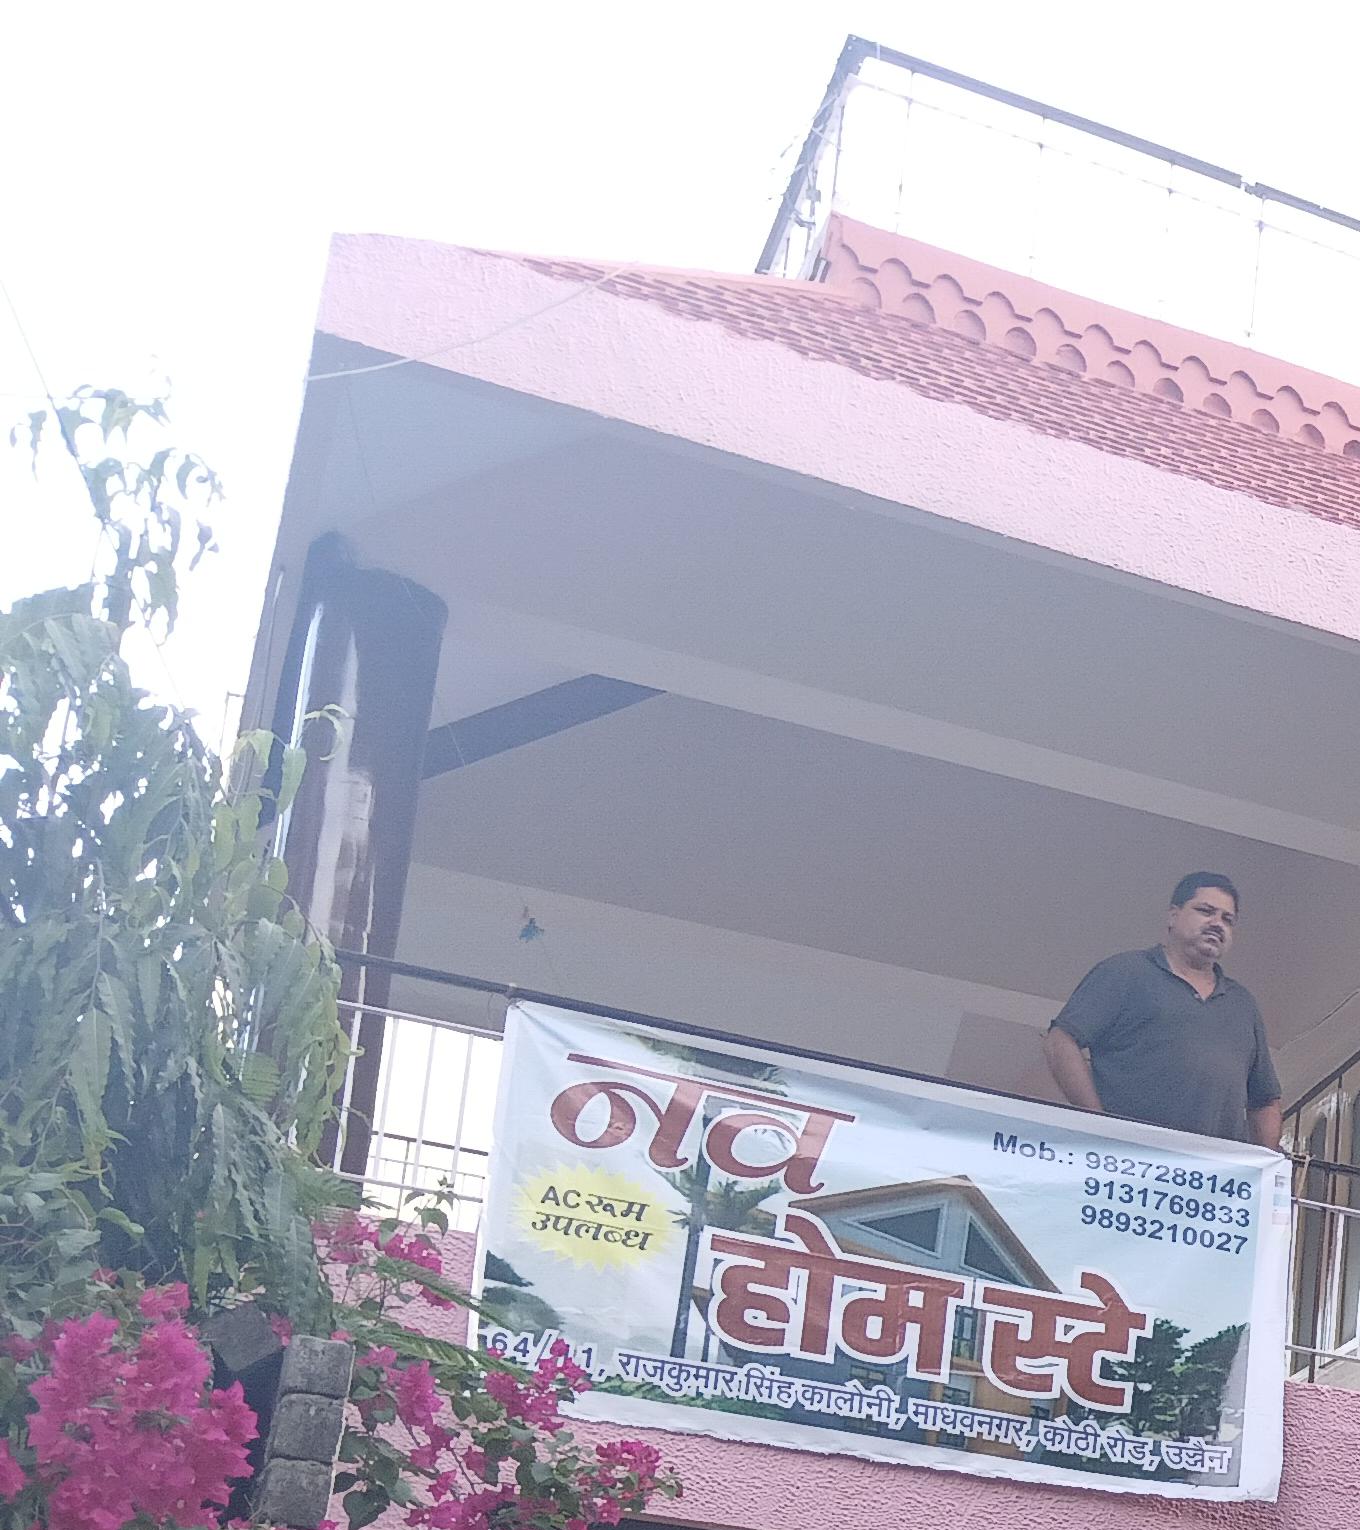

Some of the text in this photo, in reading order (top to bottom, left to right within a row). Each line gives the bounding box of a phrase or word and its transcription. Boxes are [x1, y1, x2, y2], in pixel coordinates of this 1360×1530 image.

[550, 1052, 855, 1195] नव
[992, 1131, 1252, 1201] Mob.: 9827288146
[531, 1211, 653, 1251] उपलब्ध
[1081, 1204, 1248, 1255] 9893210027
[1084, 1176, 1250, 1227] 9131769833
[711, 1214, 1147, 1407] होम स्टे
[618, 1352, 738, 1393] राजकुमार
[742, 1367, 796, 1403] सिंह
[911, 1401, 1034, 1447] माधवनगर,
[1043, 1418, 1101, 1455] कोठी
